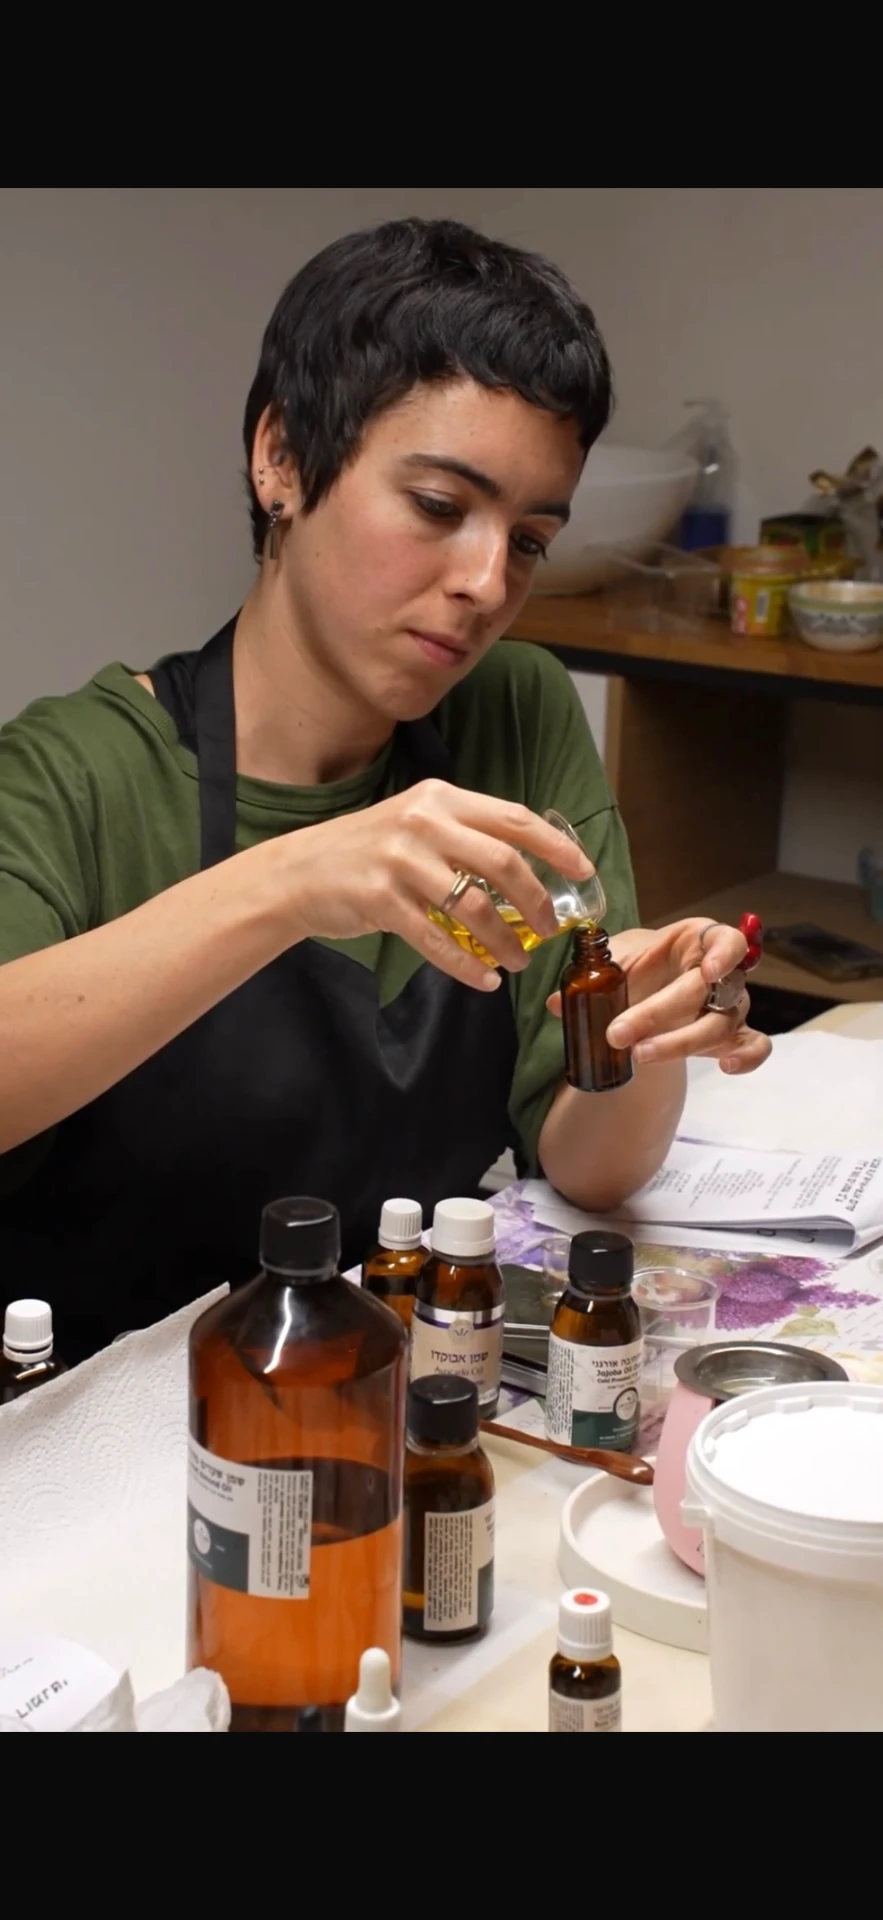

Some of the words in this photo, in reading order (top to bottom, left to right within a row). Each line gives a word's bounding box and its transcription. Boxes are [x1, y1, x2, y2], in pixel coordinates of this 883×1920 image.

[431, 1350, 466, 1363] אבוקדו
[470, 1351, 489, 1365] שמן
[592, 1360, 618, 1368] אורגני
[597, 1369, 622, 1377] Jojoba
